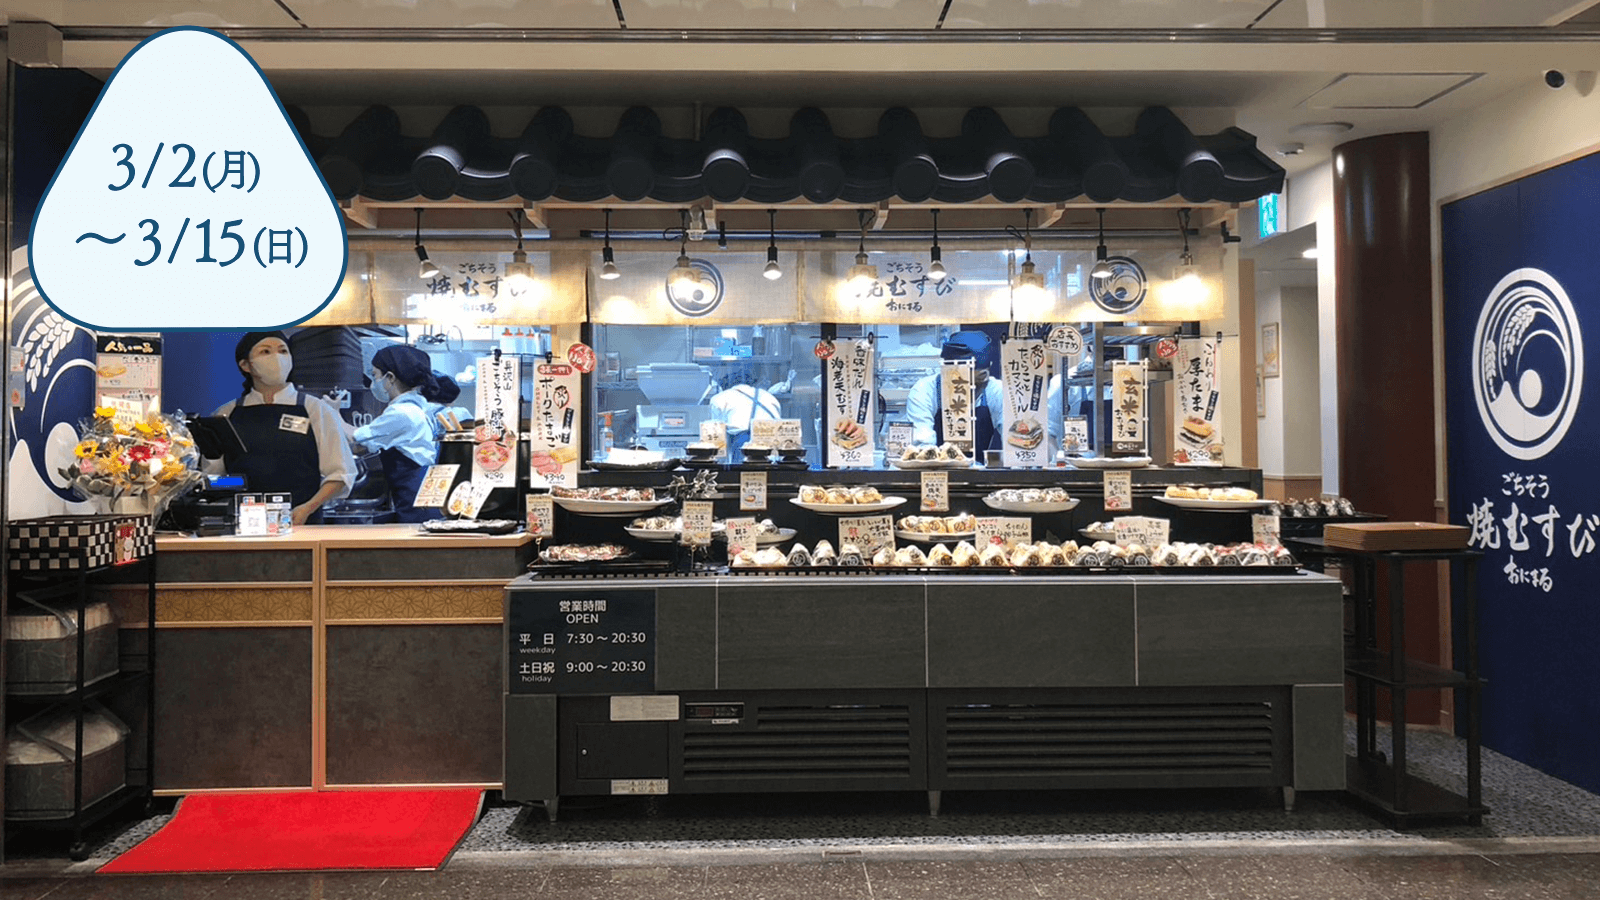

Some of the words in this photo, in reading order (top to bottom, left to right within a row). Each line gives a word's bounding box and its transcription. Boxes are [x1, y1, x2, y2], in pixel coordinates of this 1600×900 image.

[458, 263, 497, 274] ごちそう
[886, 262, 923, 273] ごちそう
[1018, 347, 1031, 392] たらこと
[949, 376, 969, 415] 玄米
[1008, 360, 1029, 413] カマンベール
[1120, 377, 1141, 415] 玄米
[1184, 357, 1204, 412] 厚たま
[539, 376, 561, 448] ポークたまご
[944, 408, 955, 437] おむすび
[1114, 408, 1126, 438] おむすび
[1015, 450, 1036, 459] ¥350
[1501, 471, 1550, 499] ごちそう
[1466, 497, 1600, 558] 焼むすび
[1503, 554, 1553, 593] おにまる
[559, 599, 607, 612] 営業時間
[566, 613, 599, 624] OPEN
[519, 662, 555, 674] 土日祝
[521, 675, 553, 683] holiday
